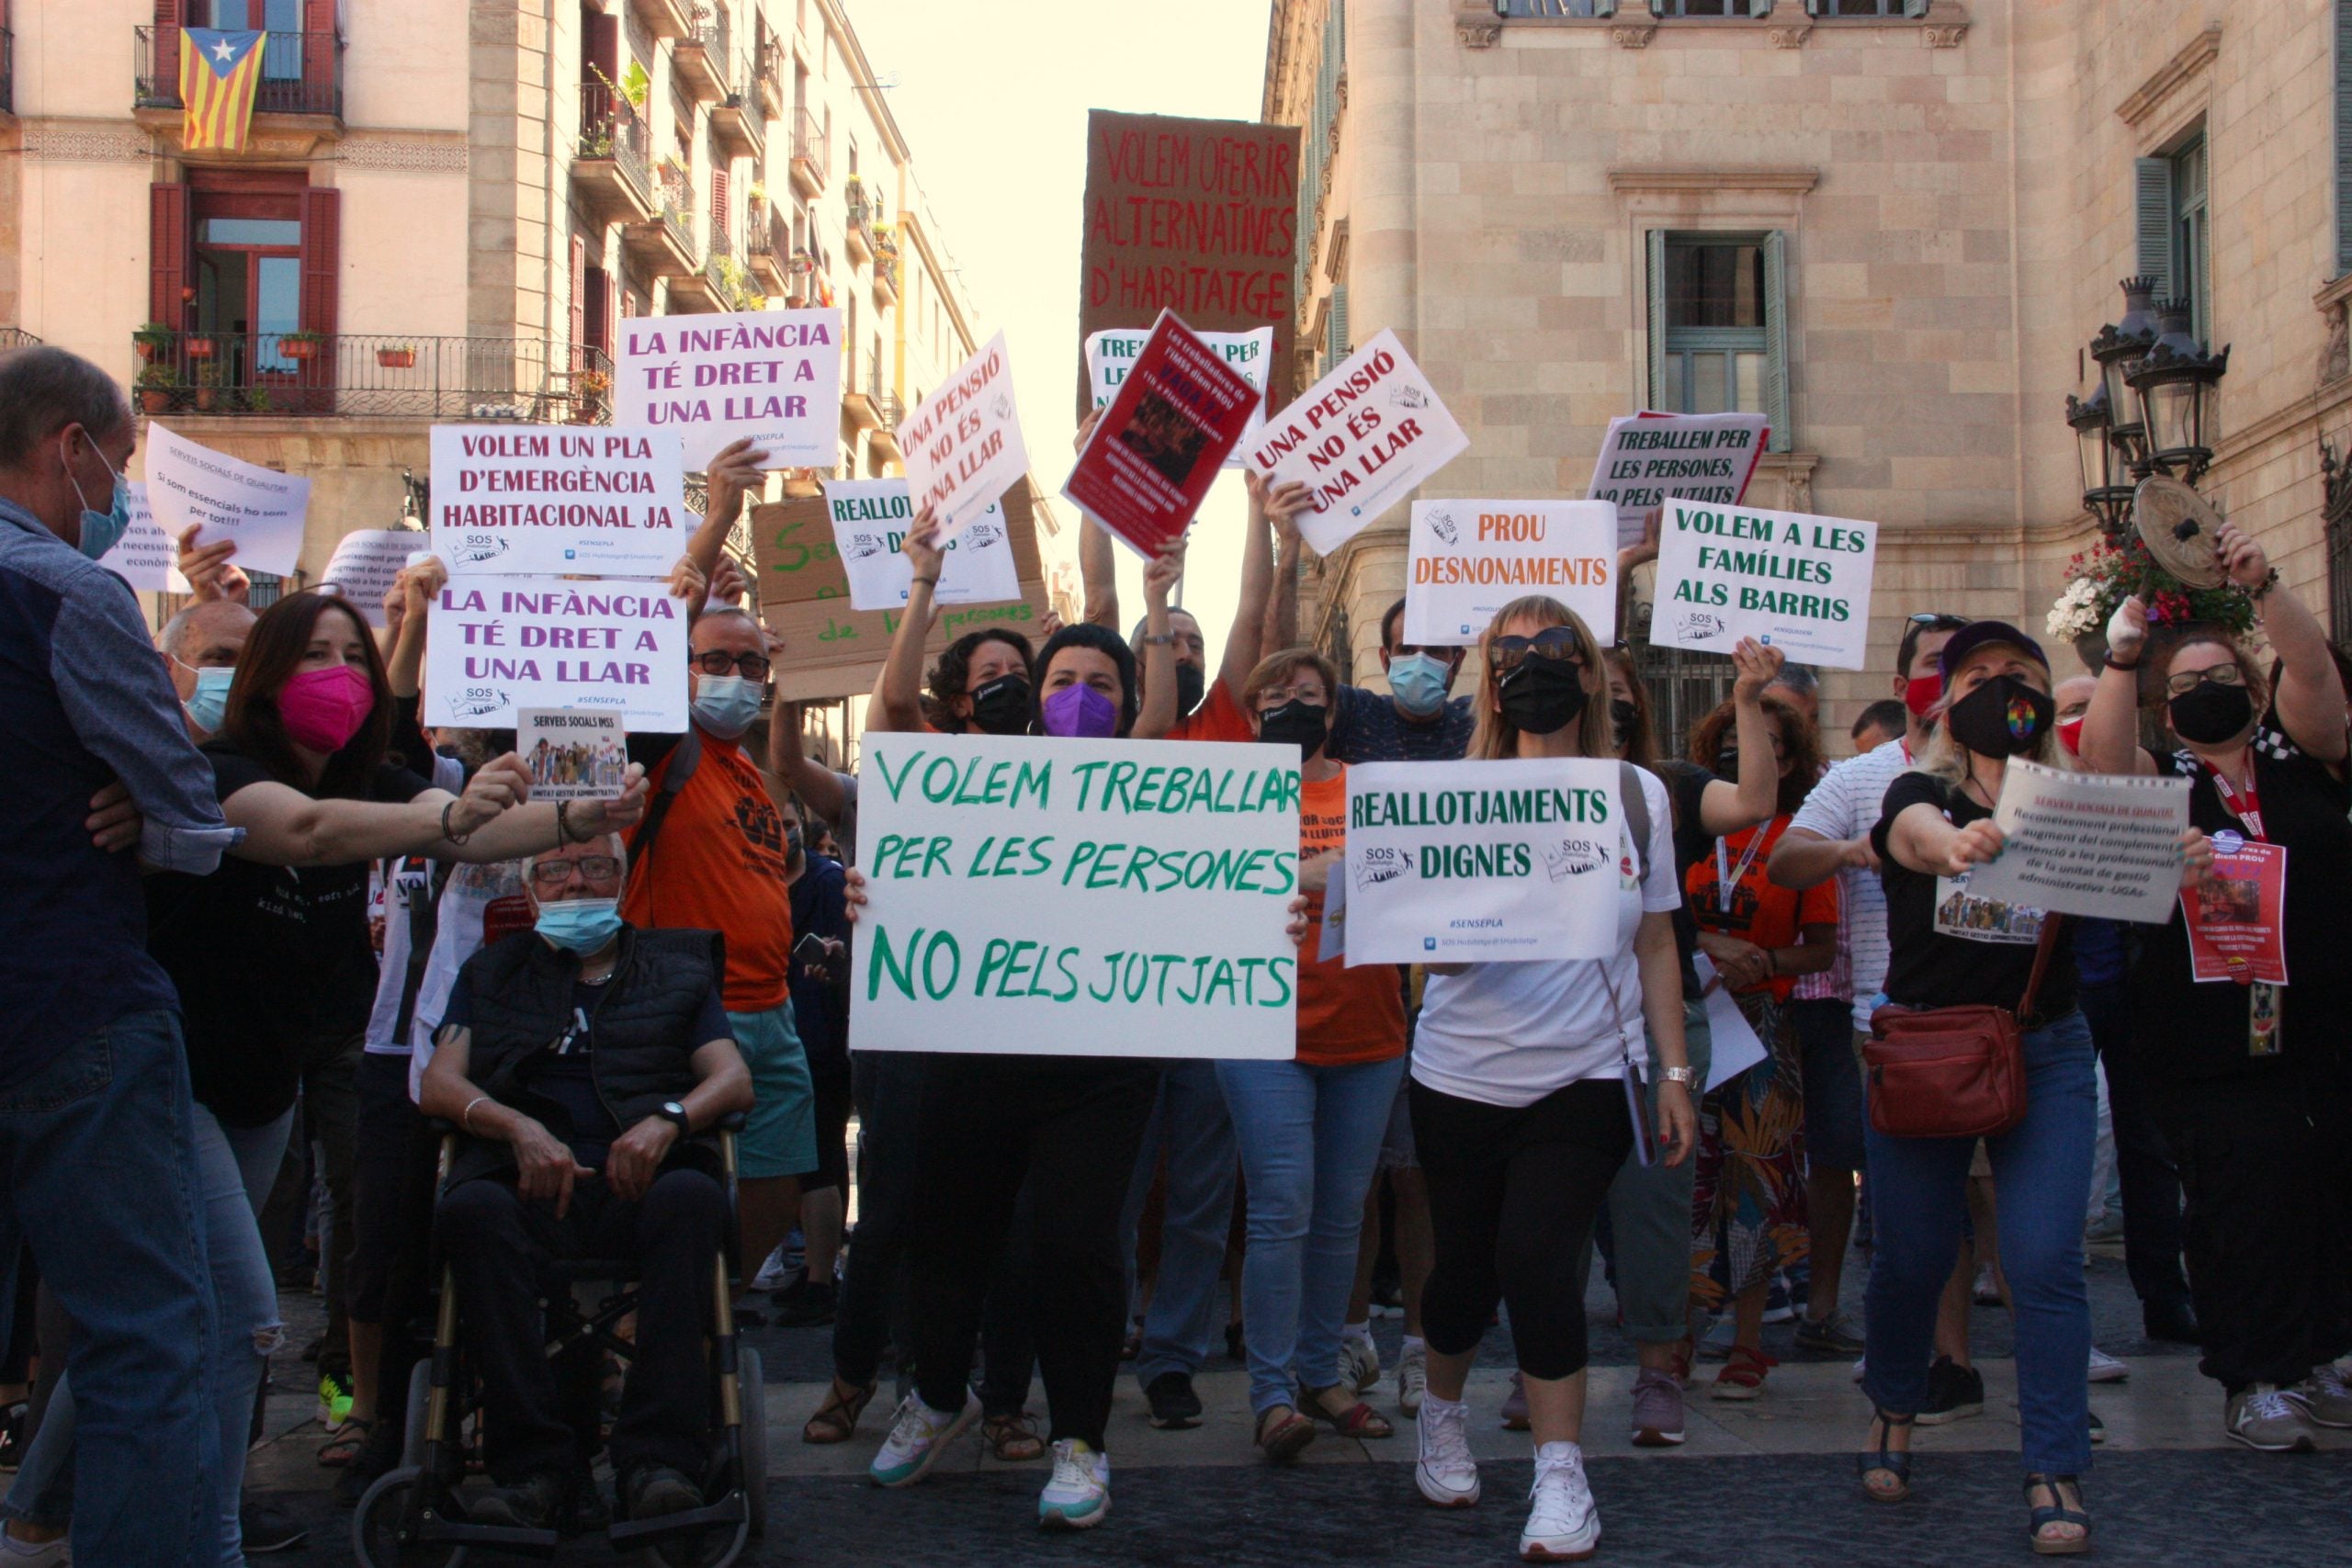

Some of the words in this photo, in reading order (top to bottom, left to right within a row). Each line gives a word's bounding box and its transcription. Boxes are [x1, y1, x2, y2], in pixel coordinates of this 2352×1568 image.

[1103, 130, 1191, 187] VOLEM
[1199, 136, 1292, 198] OFERIR
[1091, 196, 1295, 258] ALTERNATIVES
[1090, 256, 1286, 321] D'HABITATGE
[628, 332, 667, 355] LA
[679, 321, 831, 353] INFÀNCIA
[1227, 340, 1260, 363] PER
[643, 361, 682, 390] TÉ
[695, 361, 785, 388] DRET
[794, 359, 815, 382] A
[1104, 367, 1127, 385] LE
[903, 414, 933, 458] UNA
[935, 347, 1000, 426] PENSIÓ
[1211, 386, 1235, 411] PROU
[1403, 385, 1420, 397] SOS
[648, 399, 712, 425] UNA
[724, 395, 808, 422] LLAR
[1255, 424, 1307, 469] UNA
[1305, 348, 1396, 431] PENSIÓ
[462, 435, 549, 458] VOLEM
[560, 436, 594, 458] UN
[605, 436, 652, 459] PLA
[930, 433, 953, 471] NO
[957, 408, 981, 444] ÉS
[1307, 434, 1346, 472] NO
[1347, 406, 1382, 441] ÉS
[1618, 430, 1713, 450] TREBALLEM
[1715, 430, 1751, 448] PER
[169, 446, 198, 466] SERVEIS
[199, 460, 232, 478] SOCIALS
[233, 473, 245, 482] DE
[922, 471, 956, 512] UNA
[958, 429, 1003, 483] LLAR
[1307, 468, 1361, 514] UNA
[1358, 417, 1423, 476] LLAR
[1610, 460, 1642, 479] LES
[1644, 458, 1734, 479] PERSONES,
[157, 471, 165, 482] Si
[166, 479, 187, 494] som
[188, 489, 242, 514] essencials
[244, 506, 259, 516] ho
[263, 509, 287, 517] som
[459, 465, 655, 494] D'EMERGÈNCIA
[1595, 490, 1618, 502] NO
[1622, 488, 1664, 507] PELS
[189, 506, 206, 520] per
[444, 503, 636, 529] HABITACIONAL
[644, 506, 673, 529] JA
[1443, 514, 1456, 533] SOS
[467, 536, 492, 544] SOS
[854, 535, 872, 543] SOS
[972, 525, 990, 534] SOS
[1478, 514, 1545, 542] PROU
[1675, 508, 1774, 542] VOLEM
[1783, 523, 1804, 546] A
[1813, 527, 1866, 554] LES
[1415, 557, 1607, 586] DESNONAMENTS
[1698, 547, 1833, 585] FAMÍLIES
[442, 590, 486, 612] LA
[502, 589, 674, 619] INFÀNCIA
[1674, 579, 1728, 606] ALS
[1739, 586, 1849, 623] BARRIS
[818, 612, 860, 642] de
[943, 604, 1034, 640] persones
[1690, 613, 1712, 624] SOS
[459, 619, 504, 647] TÉ
[521, 626, 623, 650] DRET
[635, 630, 659, 652] A
[464, 657, 542, 682] UNA
[556, 660, 651, 685] LLAR
[467, 688, 492, 697] SOS
[578, 695, 627, 705] #SENSEPLA
[534, 716, 567, 728] SERVEIS
[569, 716, 597, 728] SOCIALS
[875, 750, 1051, 810] VOLEM
[1073, 760, 1300, 815] TREBALLAR
[1352, 788, 1608, 829] REALLOTJAMENTS
[2014, 807, 2106, 830] Reconeixement
[2109, 820, 2180, 837] professional
[2118, 805, 2130, 816] DE
[1366, 848, 1394, 860] SOS
[1563, 840, 1591, 852] SOS
[2010, 840, 2065, 859] d'atenció
[2069, 851, 2076, 859] a
[2085, 847, 2095, 861] les
[2098, 852, 2176, 870] professionals
[2022, 829, 2075, 846] augment
[2079, 833, 2098, 845] del
[2100, 836, 2173, 853] complement
[872, 833, 953, 879] PER
[967, 835, 1055, 876] LES
[1062, 840, 1296, 895] PERSONES
[1420, 842, 1532, 879] DIGNES
[2026, 857, 2041, 869] de
[2045, 859, 2056, 872] la
[2060, 864, 2093, 877] unitat
[2097, 866, 2111, 878] de
[2115, 870, 2150, 883] gestió
[2240, 854, 2265, 863] PROU
[2018, 872, 2103, 894] administrativa
[1450, 919, 1503, 928] #SENSEPLA
[868, 924, 960, 1001] NO
[975, 938, 1080, 1003] PELS
[1089, 951, 1294, 1007] JUTJATS
